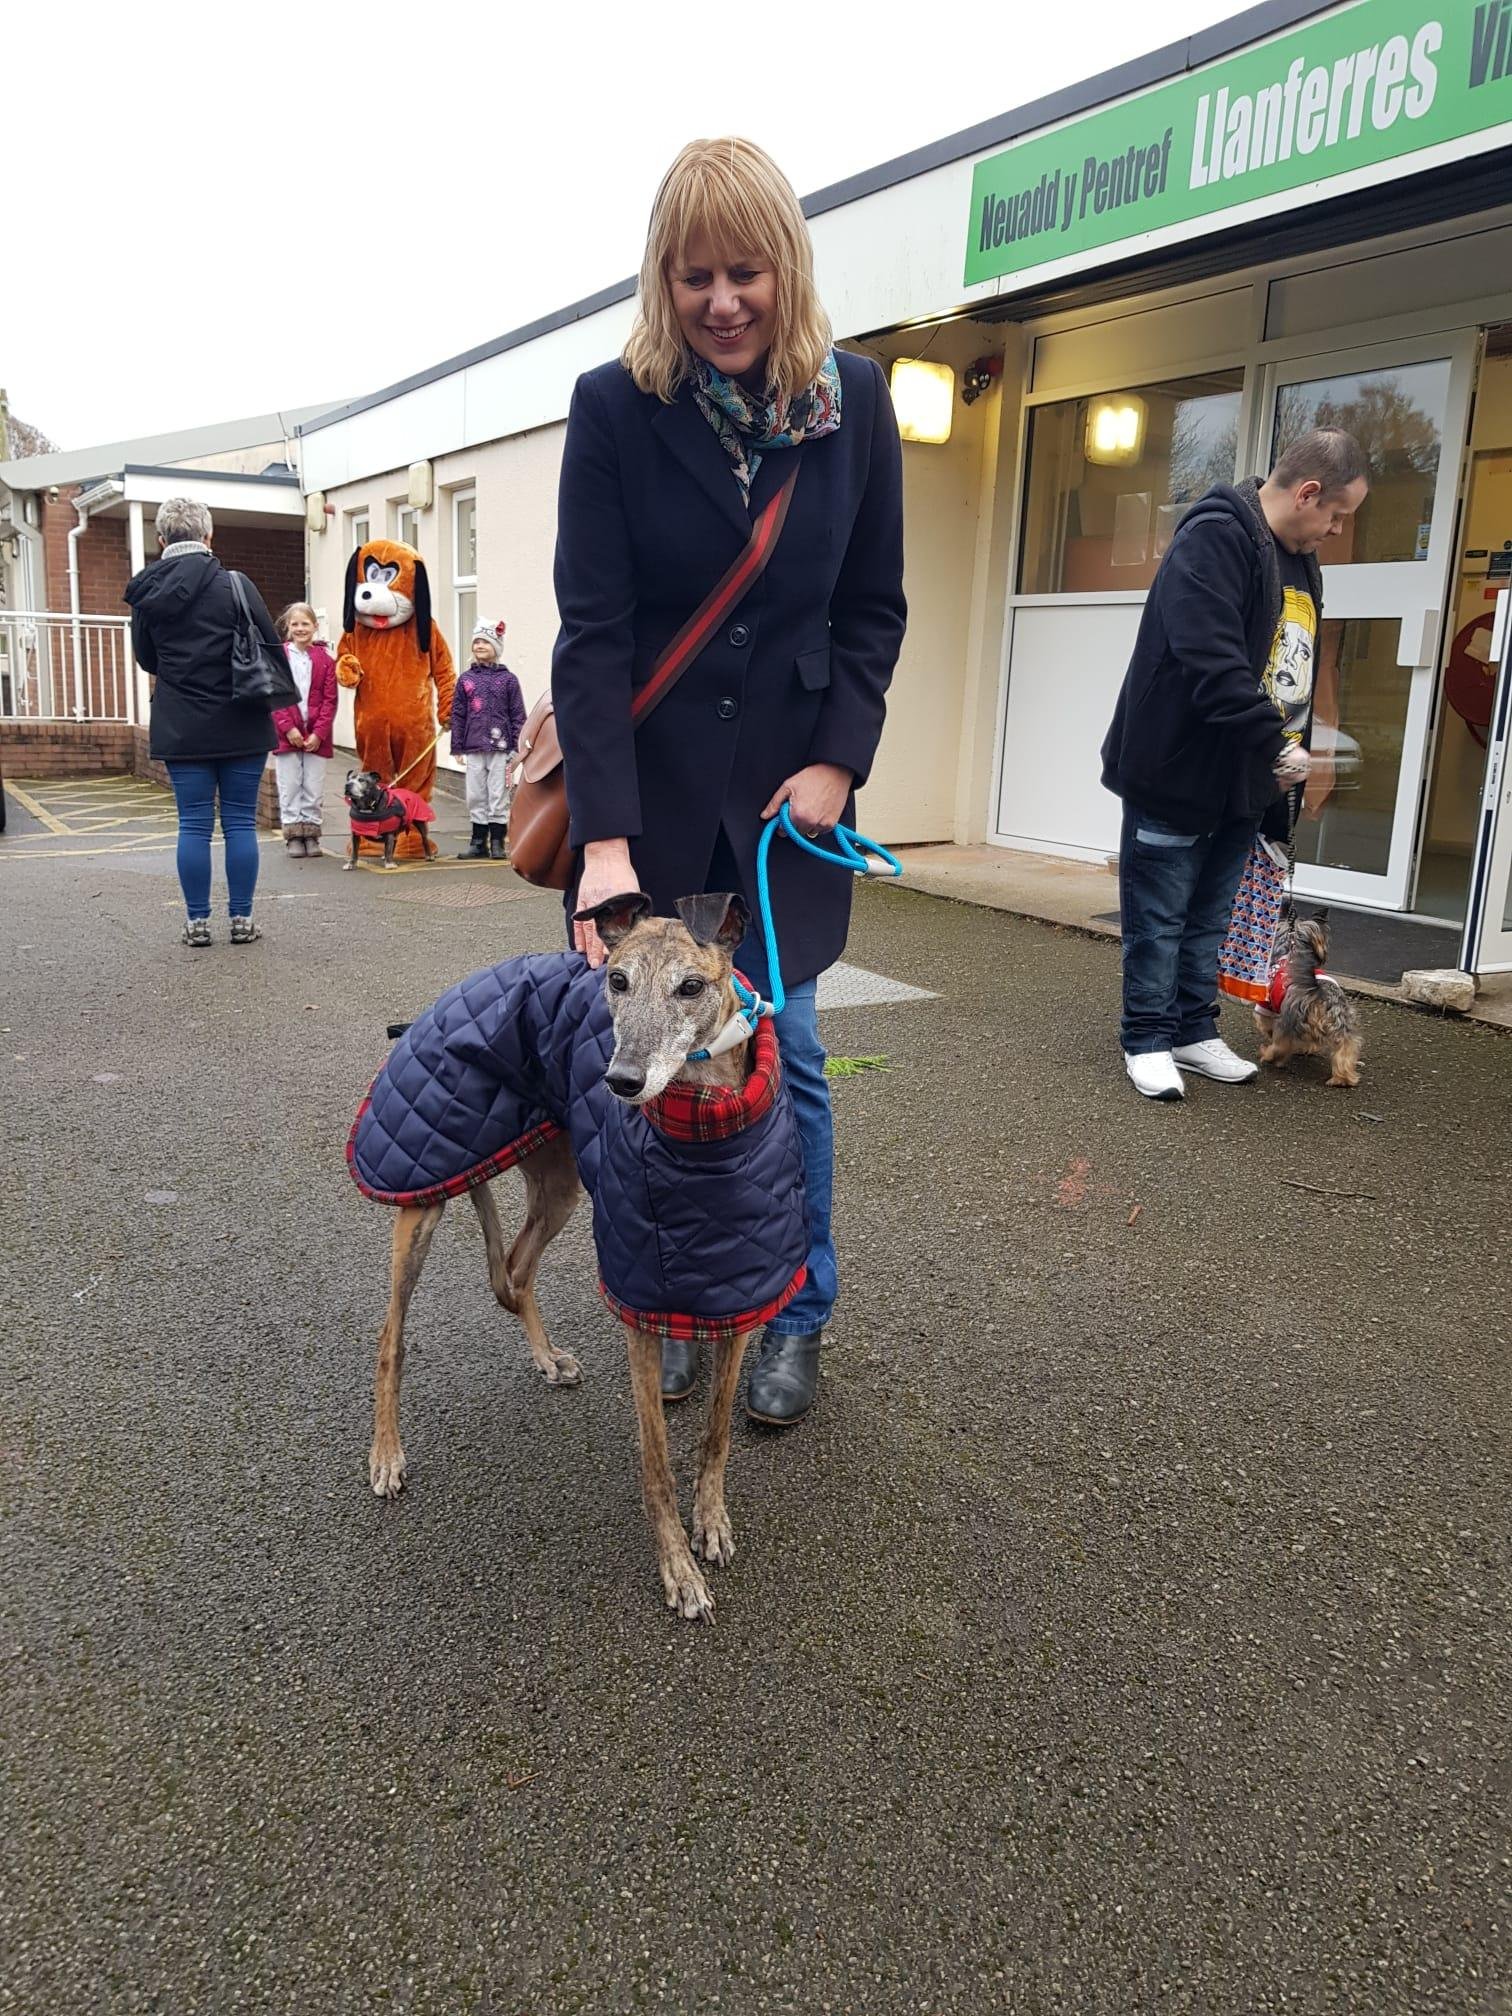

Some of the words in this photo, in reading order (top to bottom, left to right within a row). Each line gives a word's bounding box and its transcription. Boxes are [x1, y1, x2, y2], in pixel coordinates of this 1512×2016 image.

[979, 168, 1061, 252] Neuadd
[1061, 172, 1077, 232] y
[1079, 126, 1173, 220] Pentref
[1189, 20, 1443, 190] Llanferres
[1468, 0, 1512, 88] Vi
